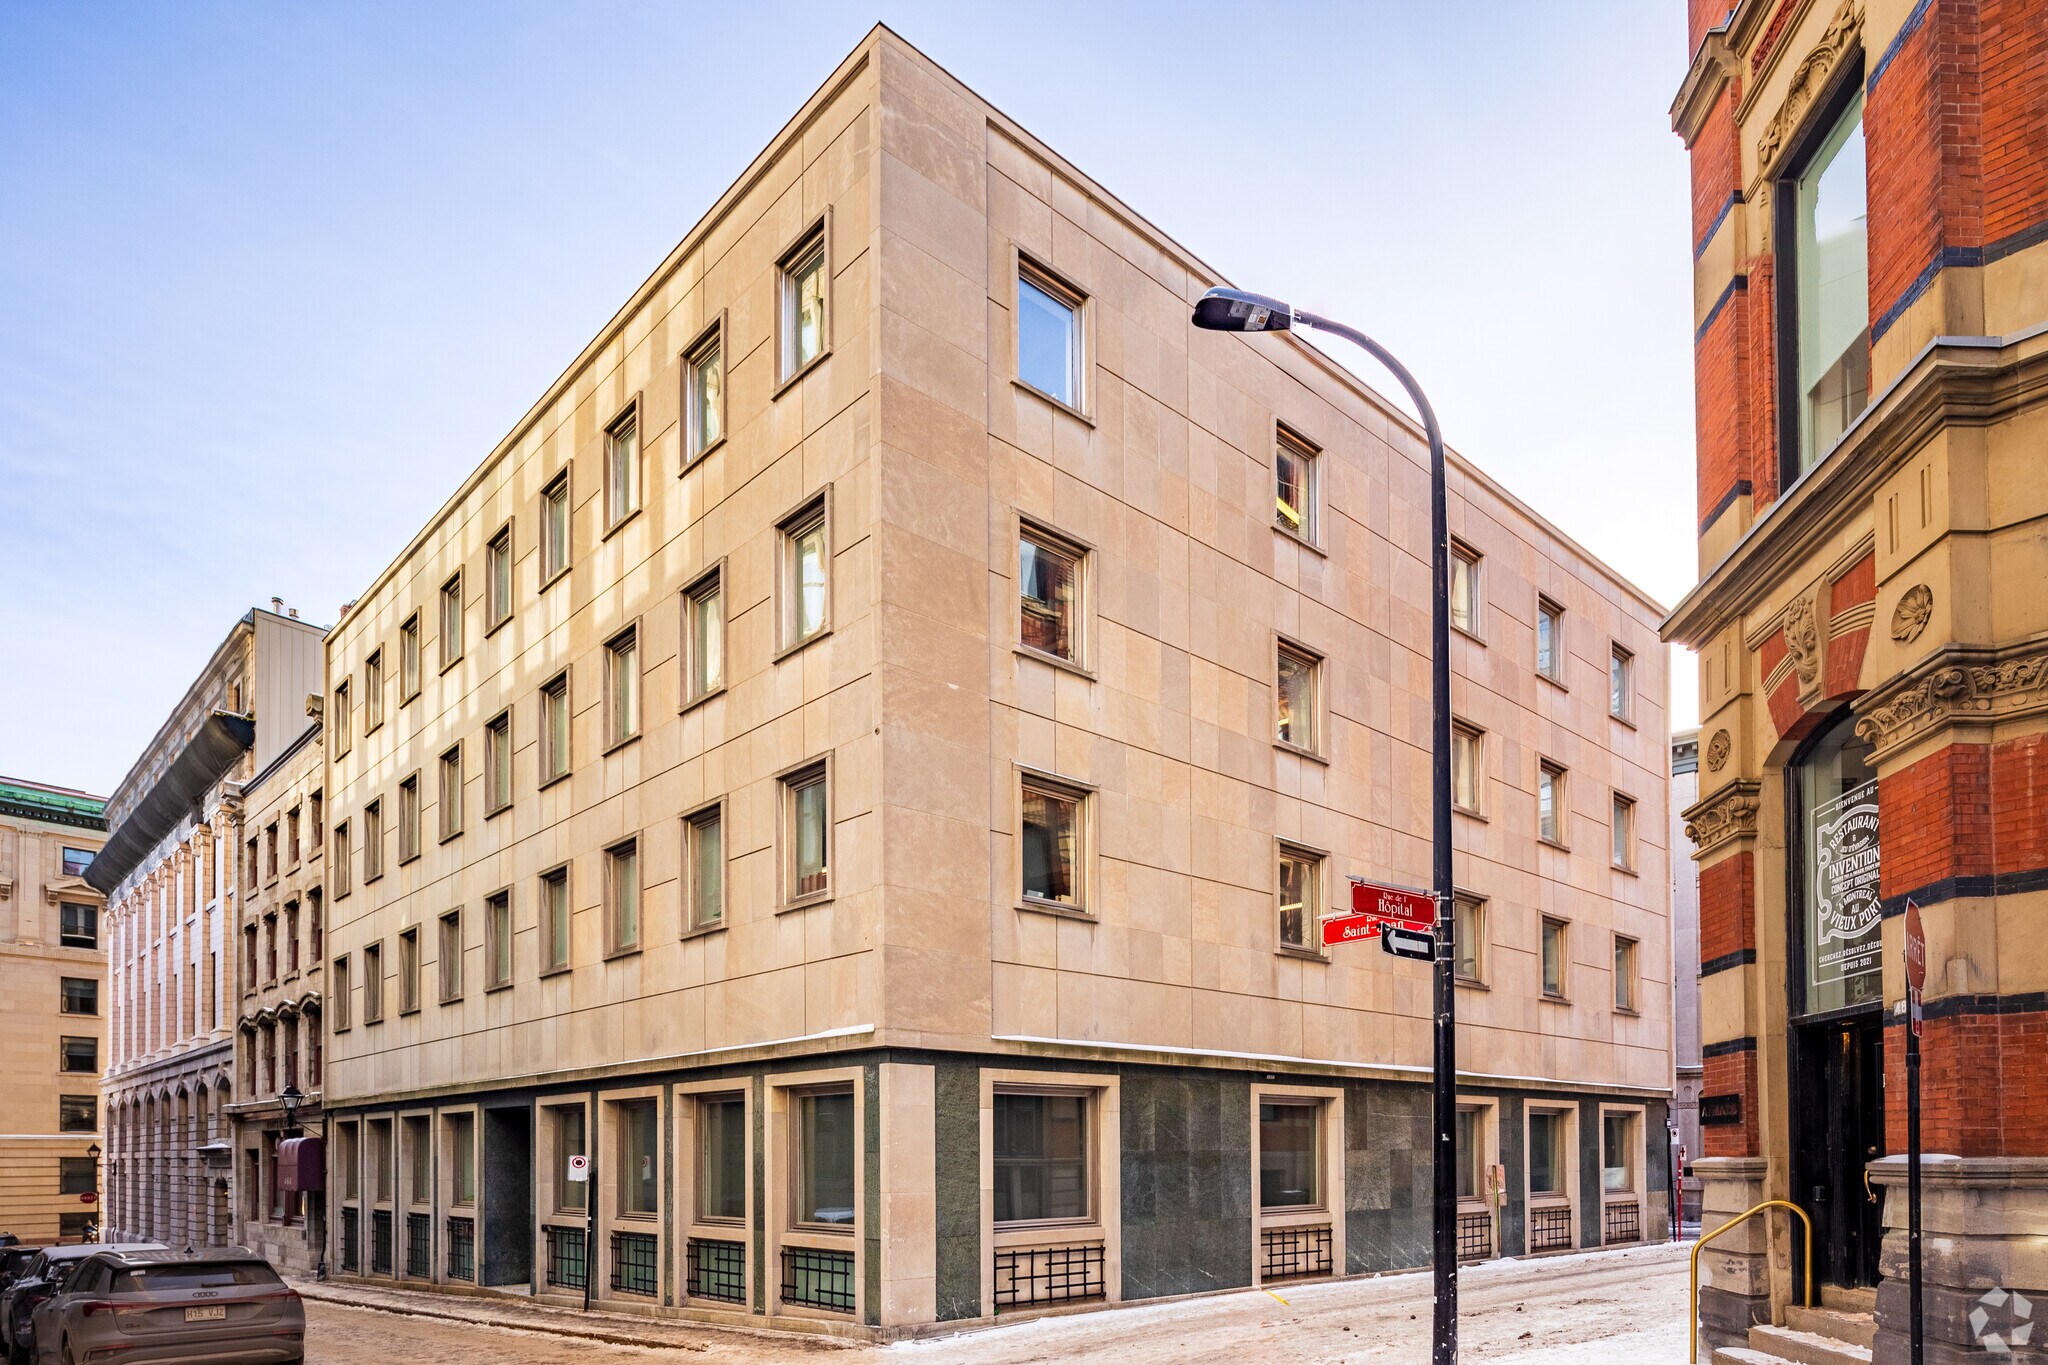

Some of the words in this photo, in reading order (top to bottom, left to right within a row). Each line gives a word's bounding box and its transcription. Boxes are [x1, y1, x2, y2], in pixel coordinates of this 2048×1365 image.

[1835, 790, 1865, 811] BIENVENUE
[1866, 786, 1874, 797] AU
[1829, 815, 1879, 850] RESTAURANT
[1831, 879, 1854, 895] CONCEPT
[1378, 898, 1413, 918] Hôpital
[1830, 910, 1857, 930] VIEUX
[1858, 896, 1882, 926] PORT
[1851, 903, 1860, 915] AU
[1906, 931, 1924, 967] ARRÊT
